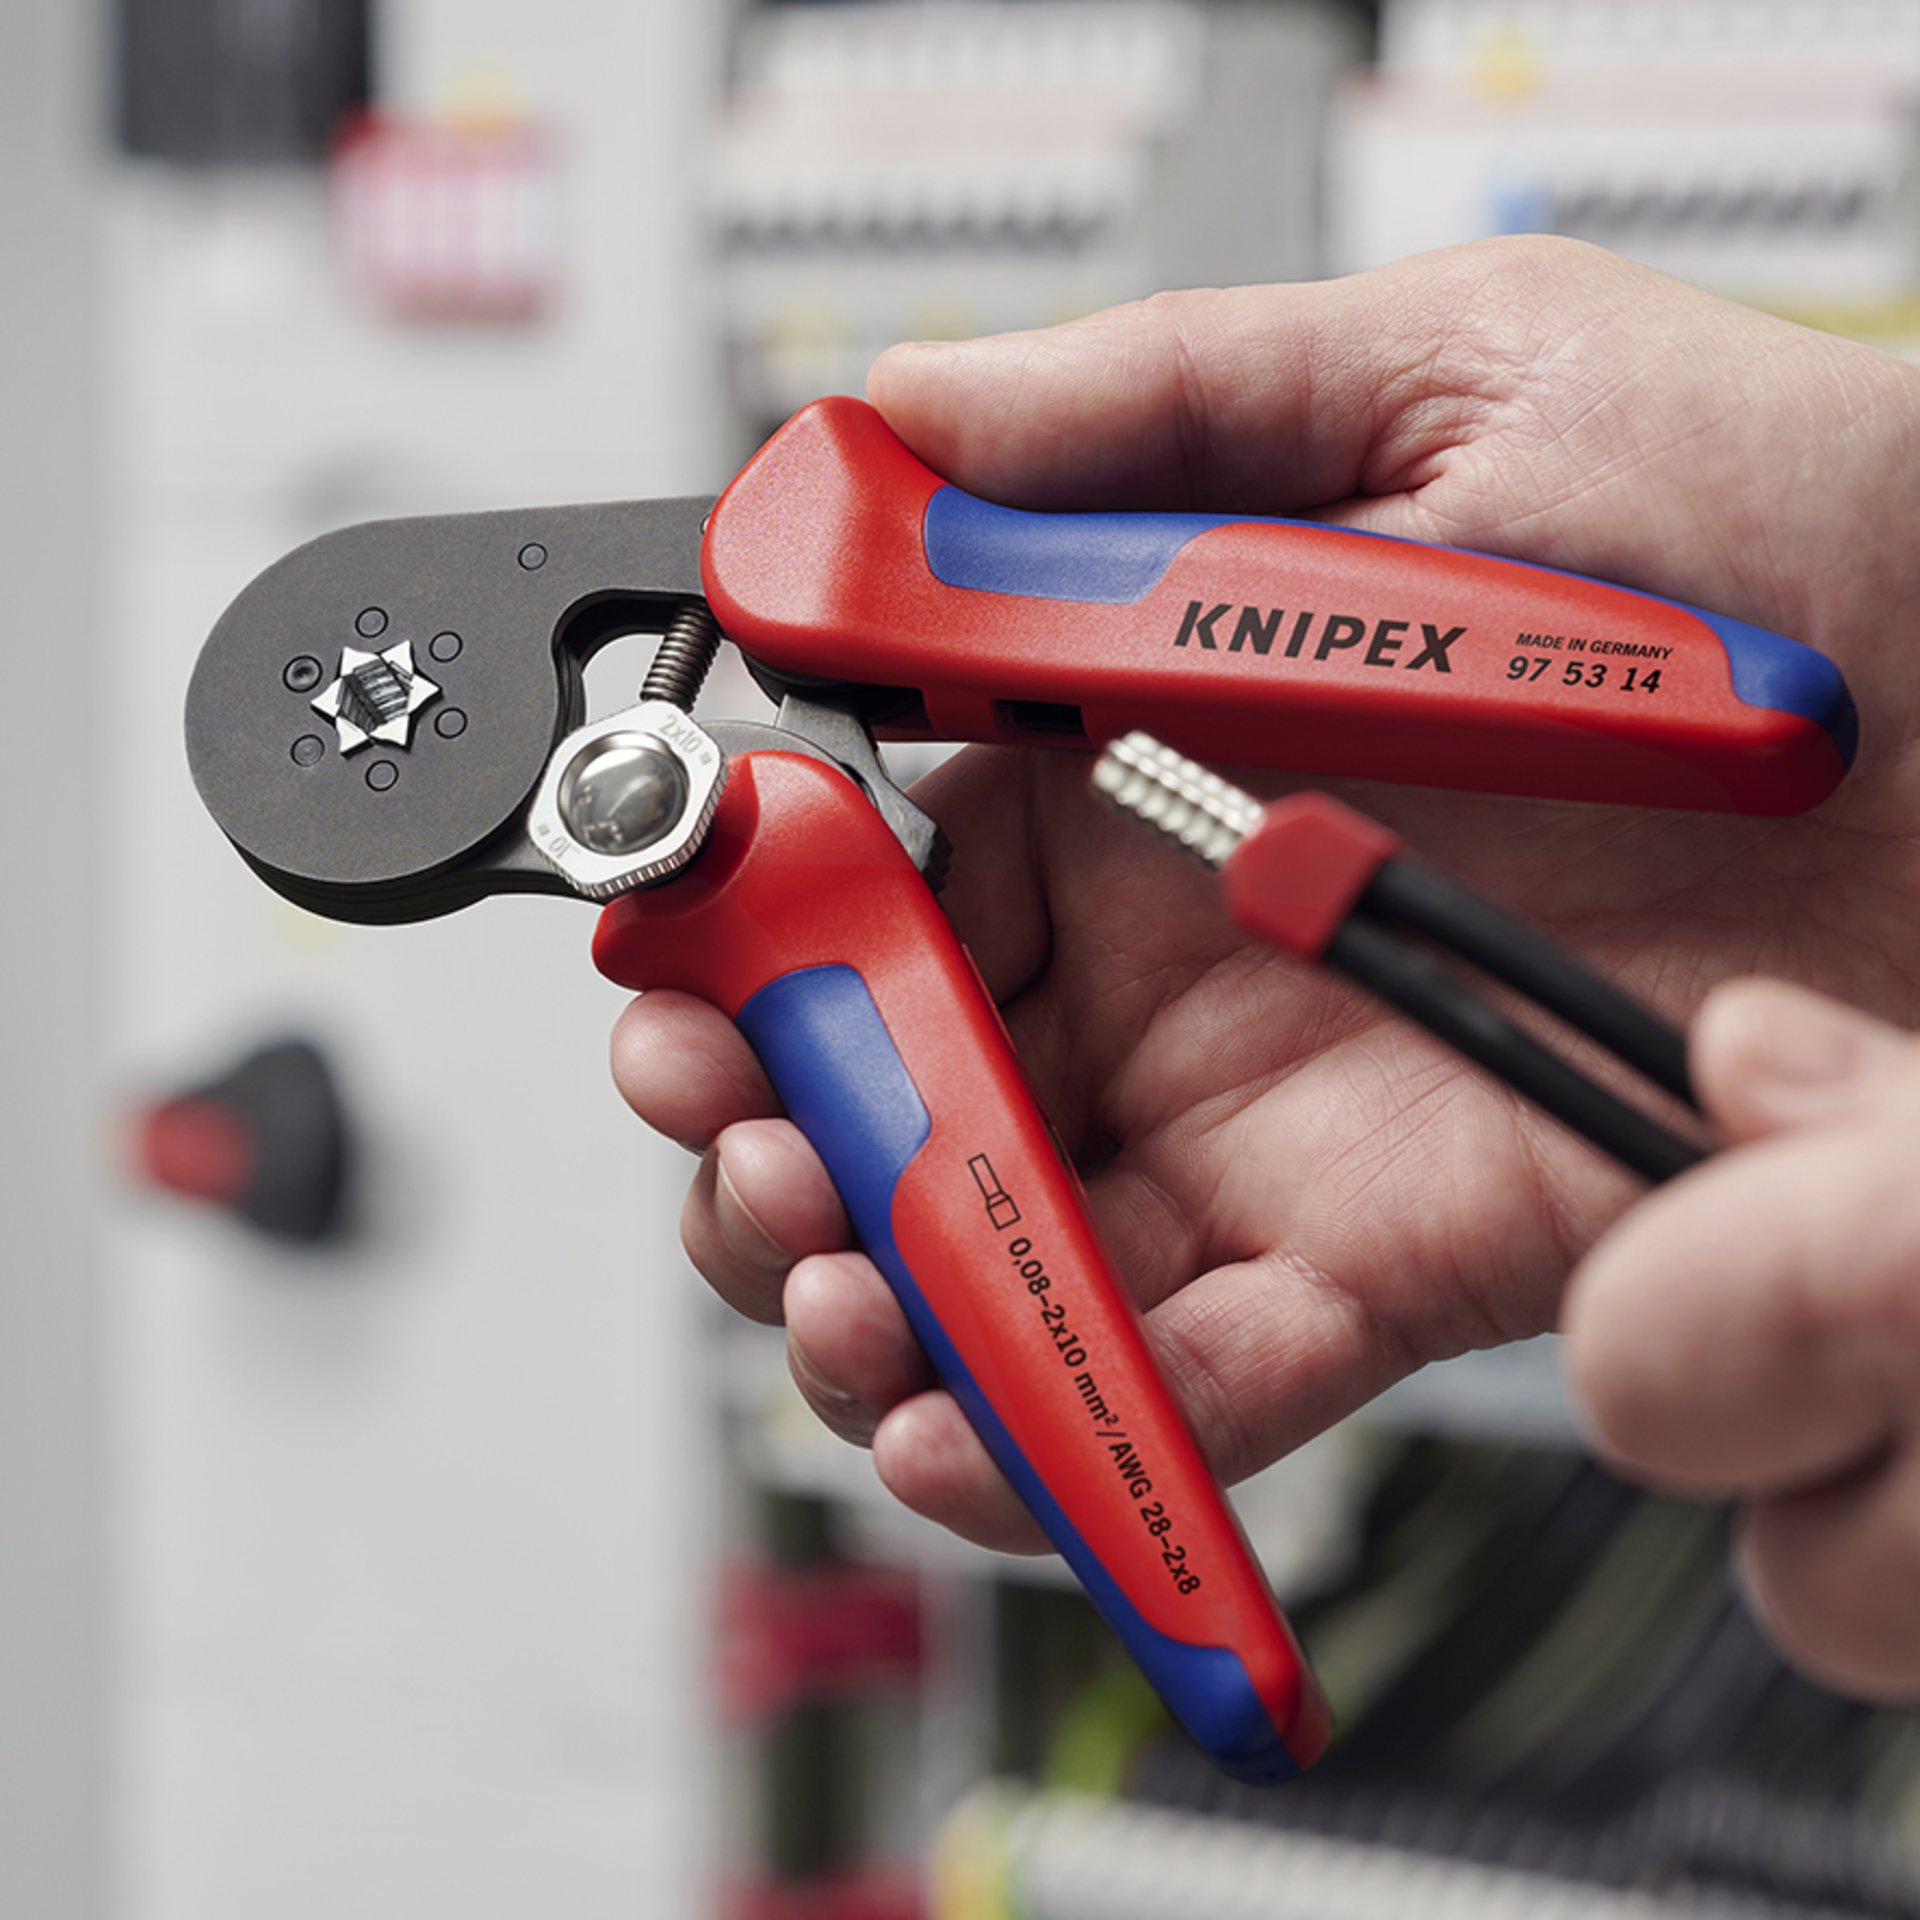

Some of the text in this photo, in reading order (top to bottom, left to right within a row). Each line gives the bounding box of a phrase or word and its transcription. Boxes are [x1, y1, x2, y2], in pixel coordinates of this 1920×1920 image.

[1173, 600, 1467, 674] KNIPEX
[1515, 632, 1674, 660] MADE IN GERMANY
[1506, 655, 1662, 694] 97 53 14
